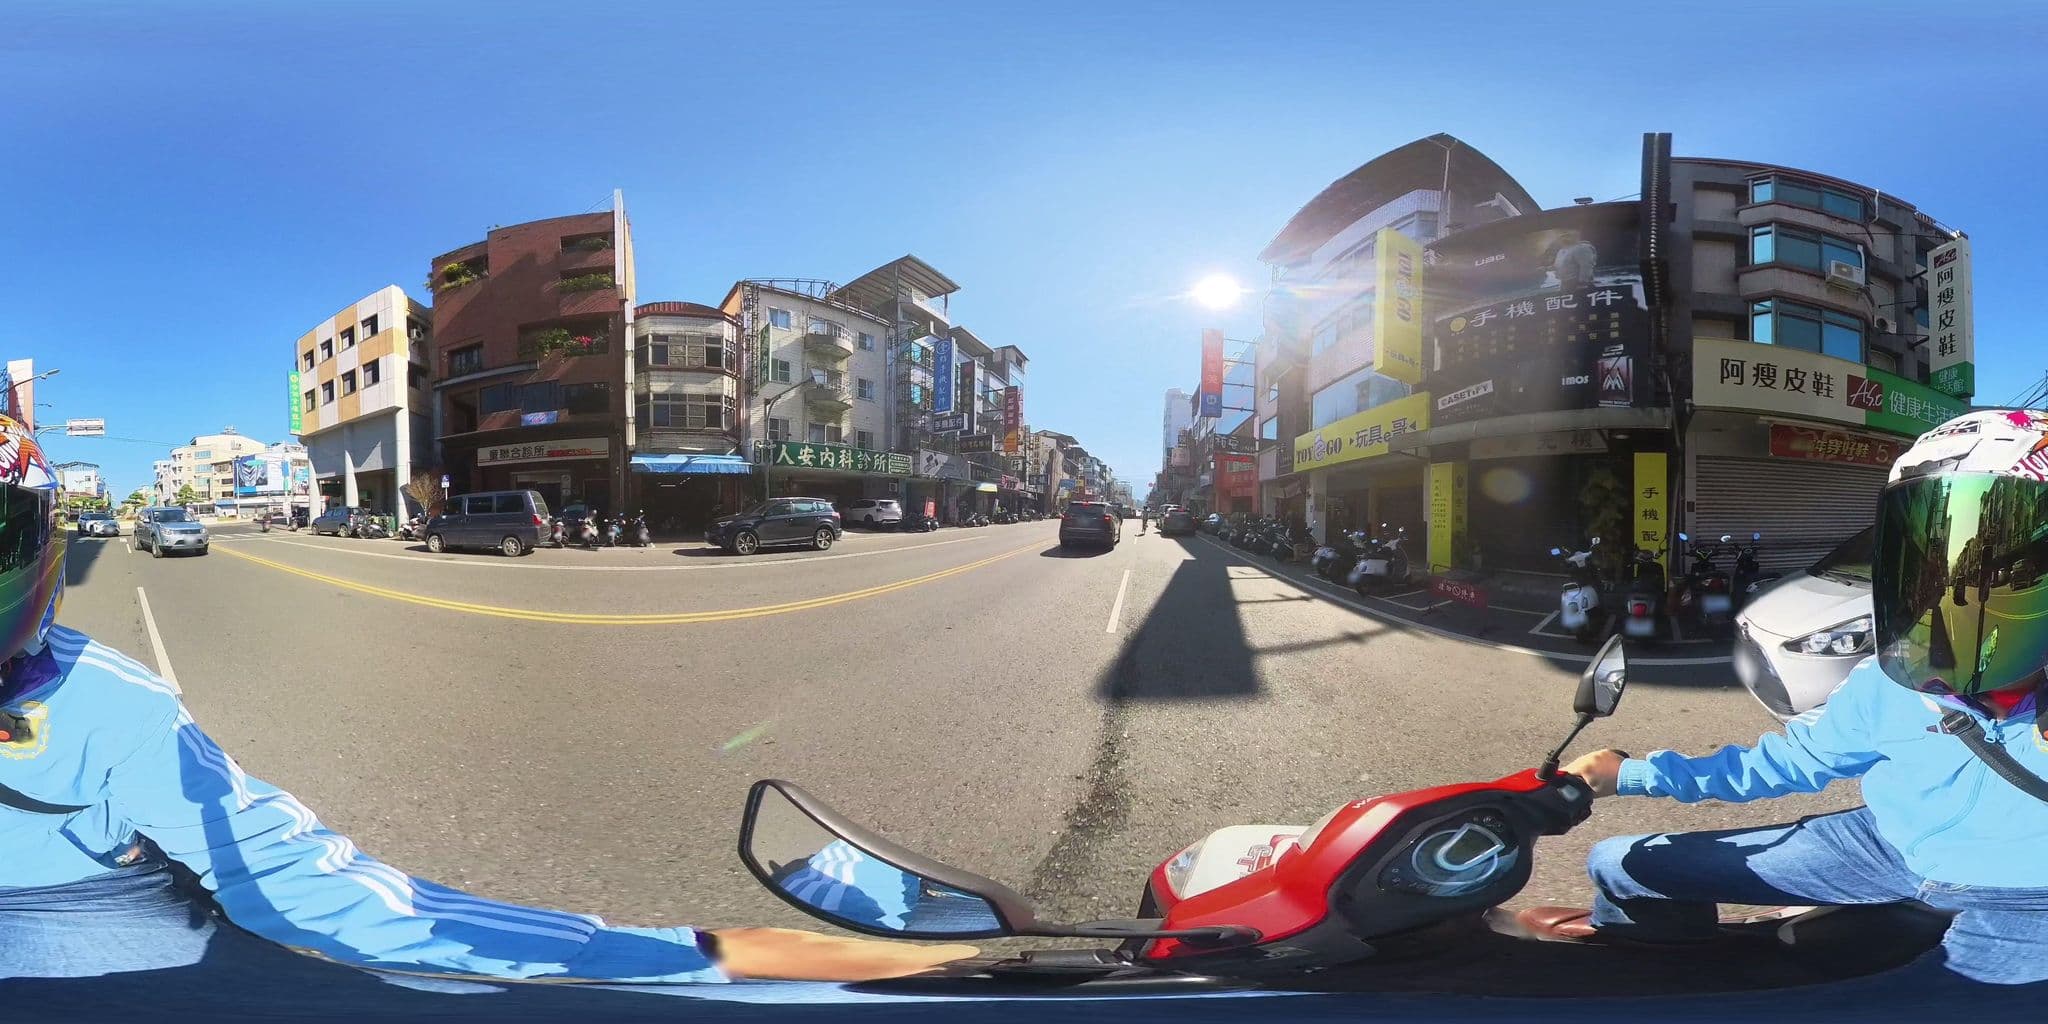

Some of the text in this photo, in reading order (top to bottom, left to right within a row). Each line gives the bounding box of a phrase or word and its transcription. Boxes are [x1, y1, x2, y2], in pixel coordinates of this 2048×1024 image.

[1470, 290, 1623, 328] 手機配件
[1936, 267, 1957, 358] 阿瘦皮鞋
[1720, 358, 1835, 399] 阿瘦皮鞋
[776, 444, 888, 473] 人安內科診所
[1327, 437, 1343, 456] GO
[1641, 486, 1659, 542] 手機配
